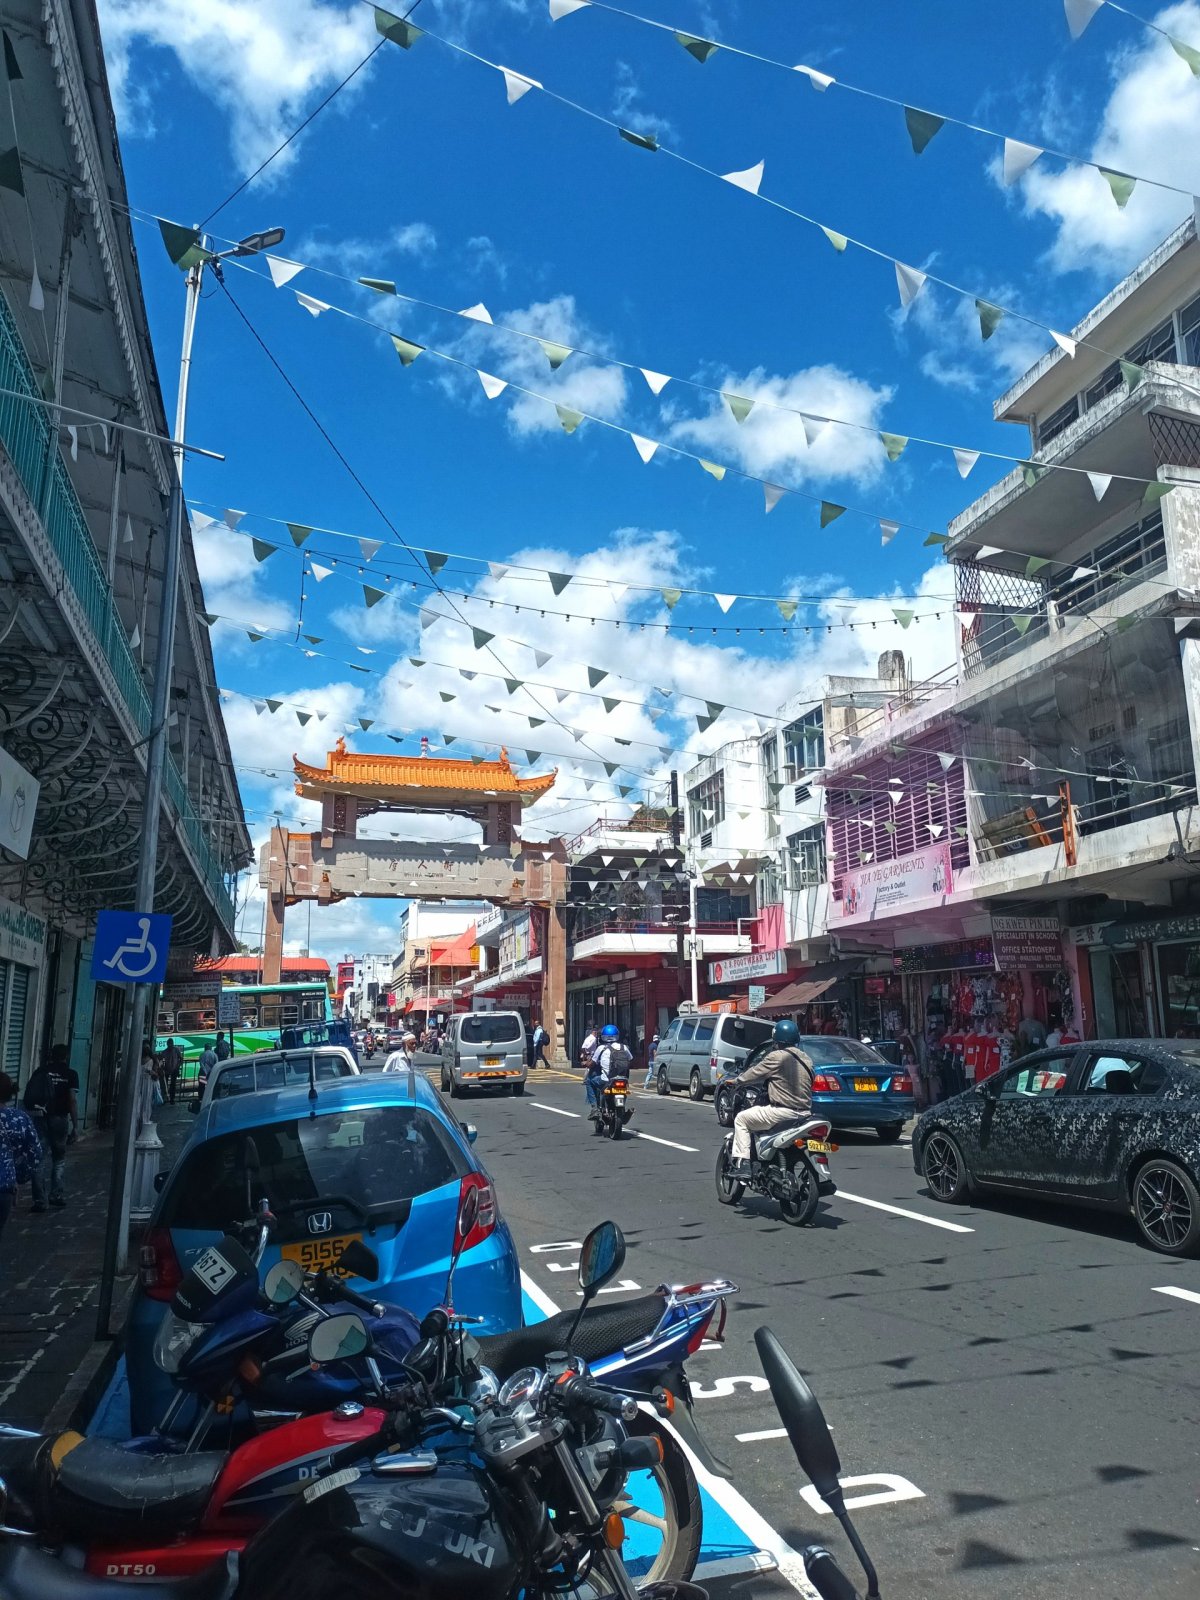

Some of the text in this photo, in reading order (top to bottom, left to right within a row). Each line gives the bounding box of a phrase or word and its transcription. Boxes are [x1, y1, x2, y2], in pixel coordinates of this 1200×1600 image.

[883, 857, 925, 882] GARMENTS
[996, 932, 1027, 940] SPECIALIST
[1035, 932, 1058, 940] SCHOOL
[734, 954, 763, 967] FOOTWEAR
[765, 952, 776, 961] LTD
[301, 1239, 344, 1262] 5156
[106, 1564, 157, 1576] DT50
